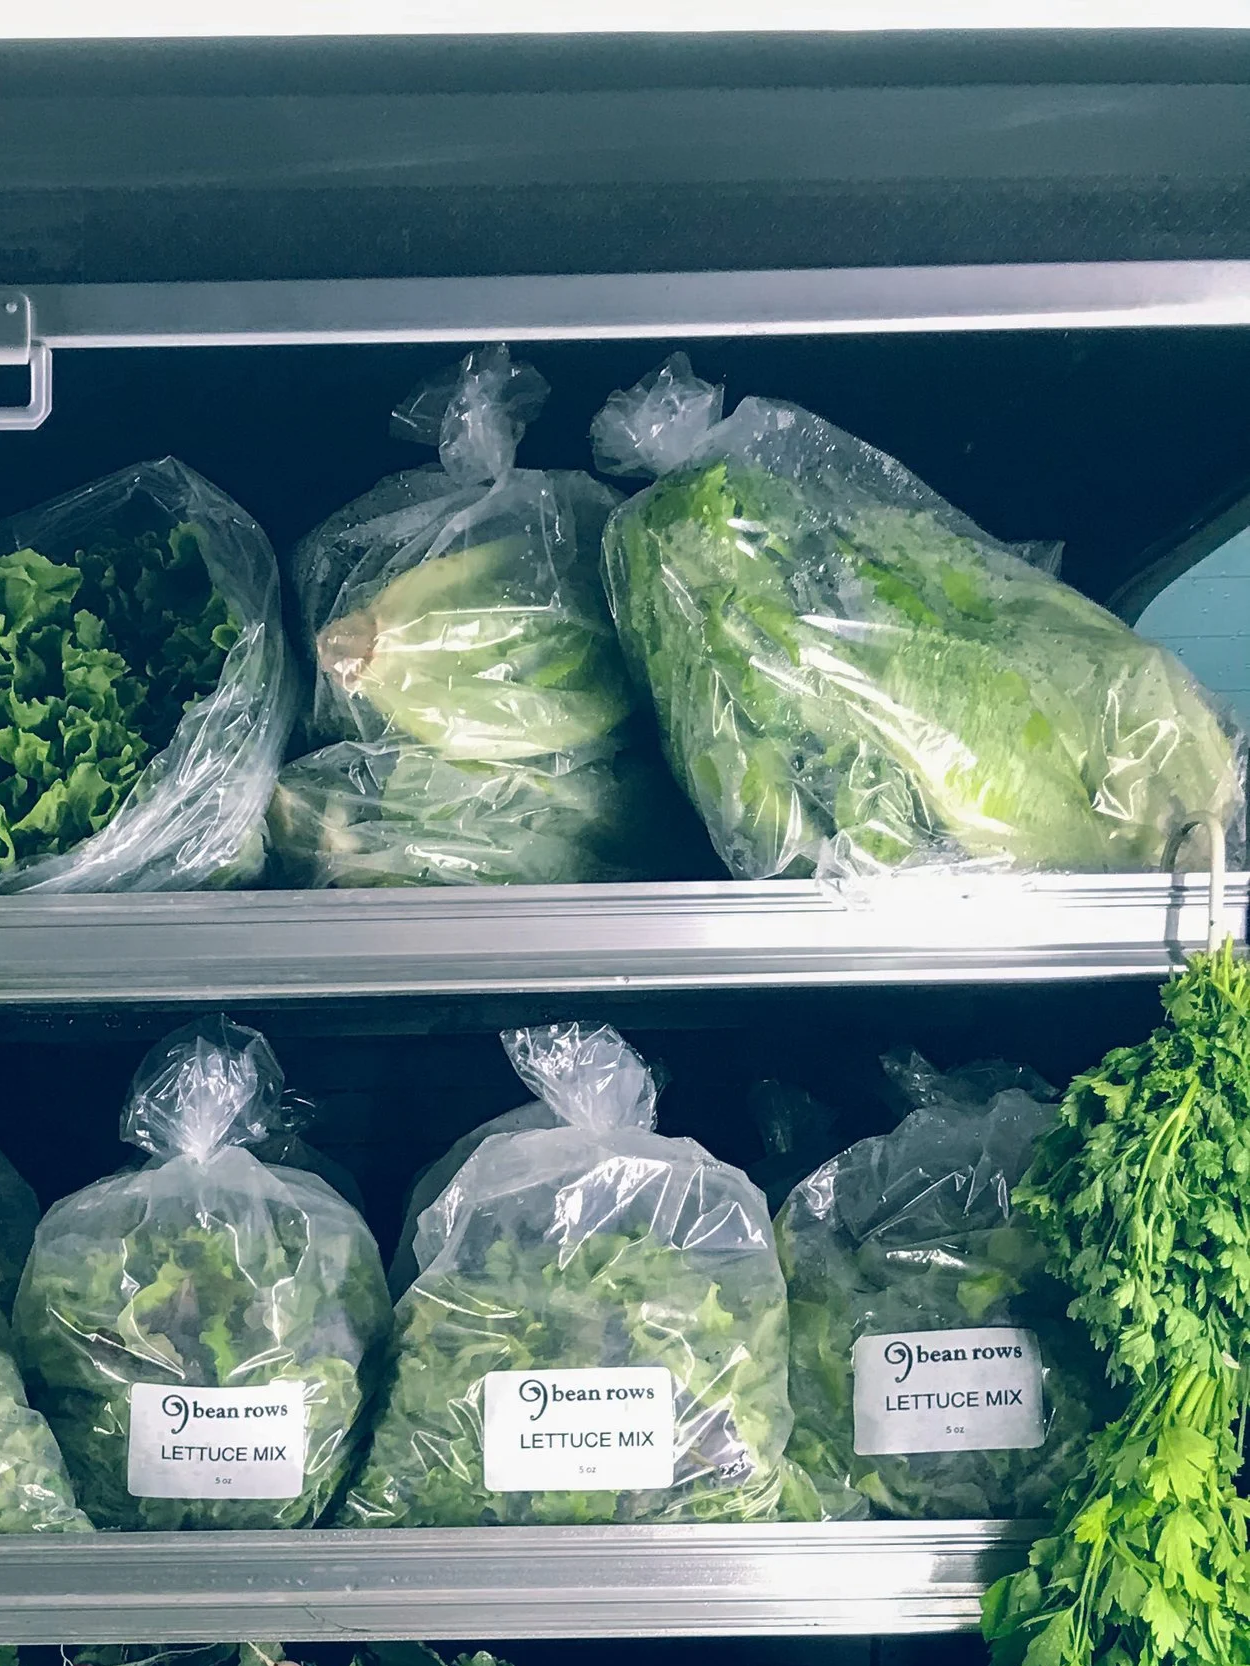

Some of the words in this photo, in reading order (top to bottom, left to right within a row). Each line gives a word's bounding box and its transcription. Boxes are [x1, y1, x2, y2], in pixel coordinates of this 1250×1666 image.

[916, 1345, 968, 1363] bean
[972, 1346, 1023, 1360] rows
[552, 1384, 601, 1402] bean
[606, 1387, 655, 1400] rows
[886, 1391, 979, 1411] LETTUCE
[986, 1389, 1023, 1406] MIX
[193, 1401, 239, 1419] bean
[244, 1404, 288, 1418] rows
[521, 1432, 612, 1449] LETTUCE
[619, 1431, 654, 1447] MIX
[162, 1445, 247, 1462] LETTUCE
[253, 1446, 287, 1461] MIX
